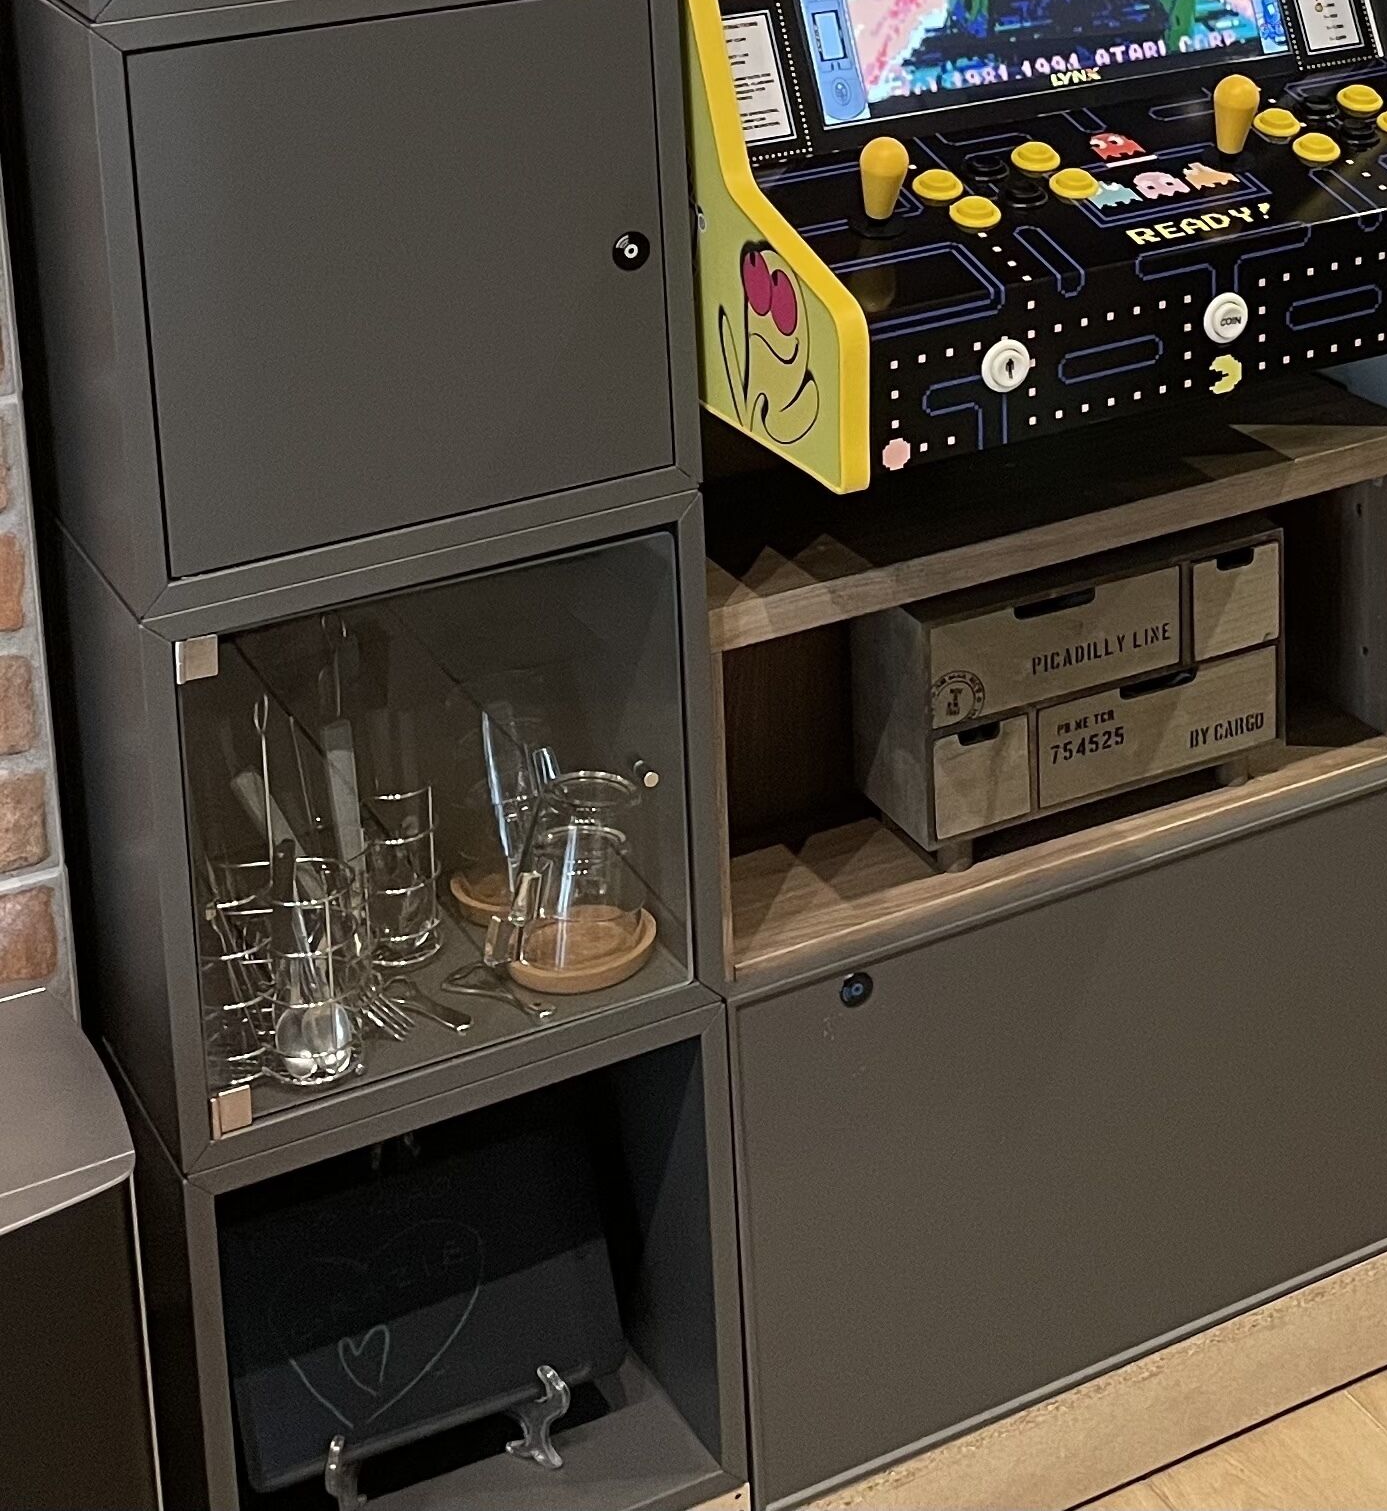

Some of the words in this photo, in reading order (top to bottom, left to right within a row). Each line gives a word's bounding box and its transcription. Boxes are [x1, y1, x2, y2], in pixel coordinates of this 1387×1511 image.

[1094, 38, 1167, 67] ATARI
[1051, 66, 1102, 87] LYNX
[1125, 201, 1271, 245] READY!
[1219, 315, 1242, 327] COIN
[1031, 633, 1127, 676] PICADILLY
[1132, 622, 1172, 649] LINE
[1049, 725, 1126, 765] 754525
[1188, 725, 1210, 749] BY
[1213, 711, 1265, 742] CARGO
